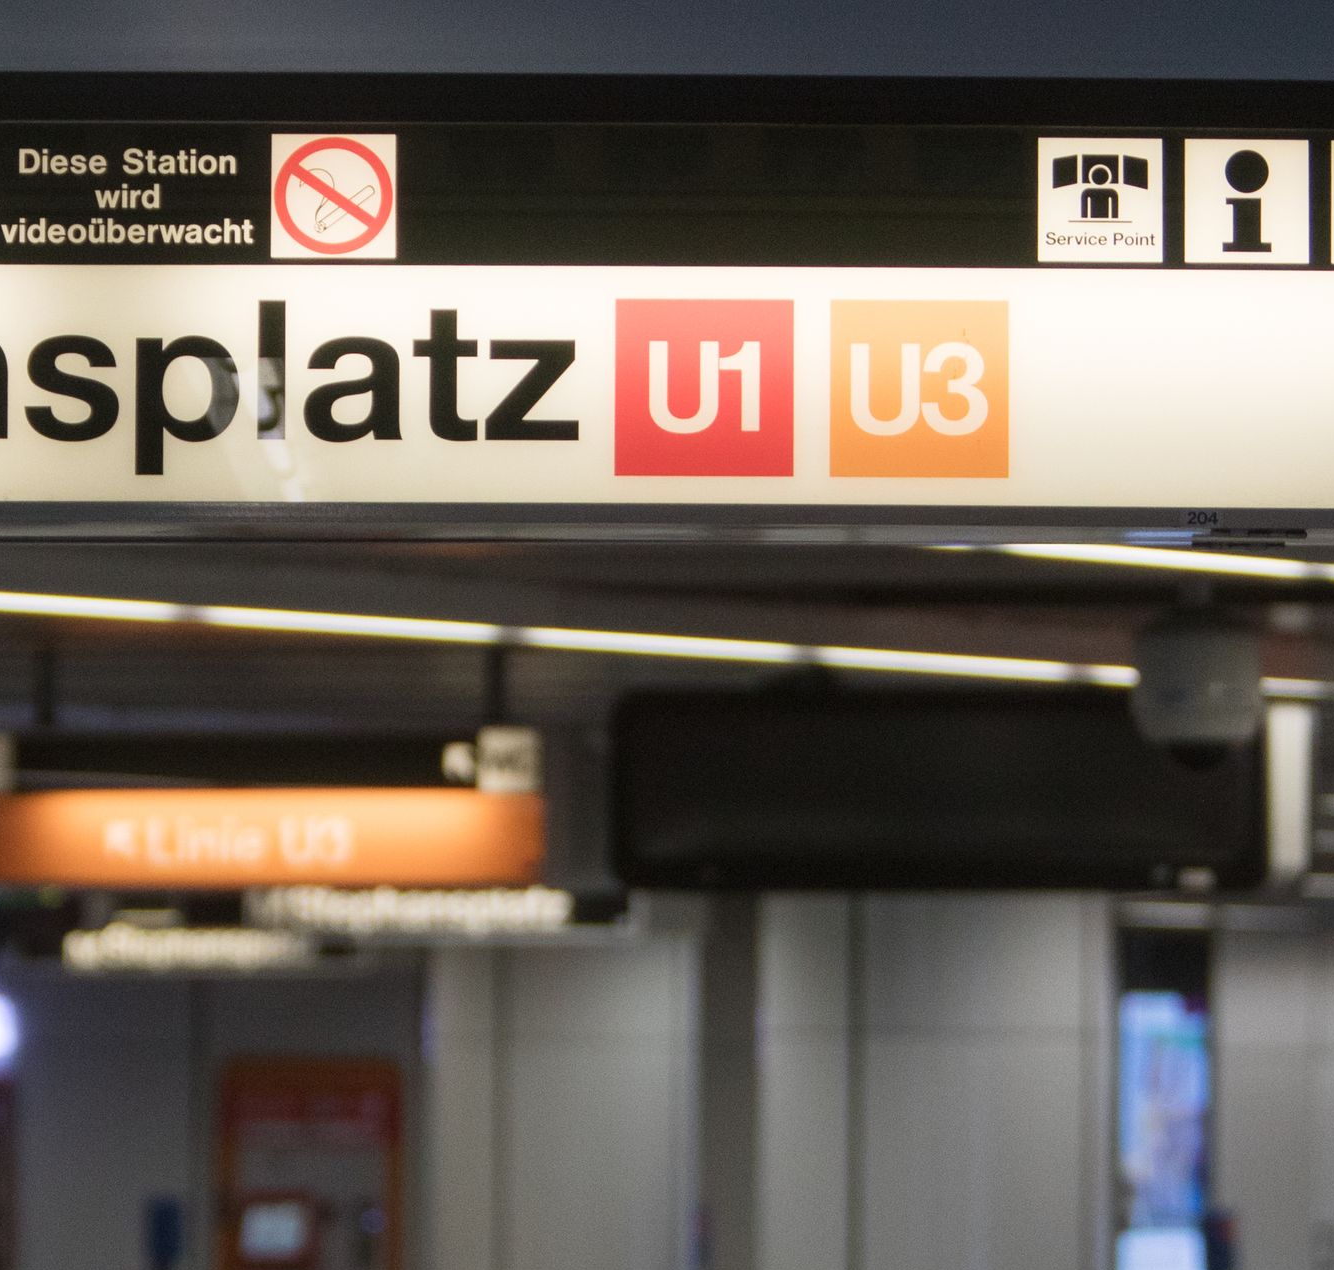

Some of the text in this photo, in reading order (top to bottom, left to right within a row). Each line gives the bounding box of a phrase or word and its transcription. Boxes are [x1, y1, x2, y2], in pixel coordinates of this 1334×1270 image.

[18, 147, 237, 175] Diese Station
[95, 184, 160, 210] wird
[0, 217, 255, 246] videoüberwacht
[1045, 231, 1156, 247] Service Point
[648, 340, 761, 435] U1
[849, 341, 989, 437] U3
[1186, 510, 1219, 526] 204
[146, 816, 269, 867] Linie
